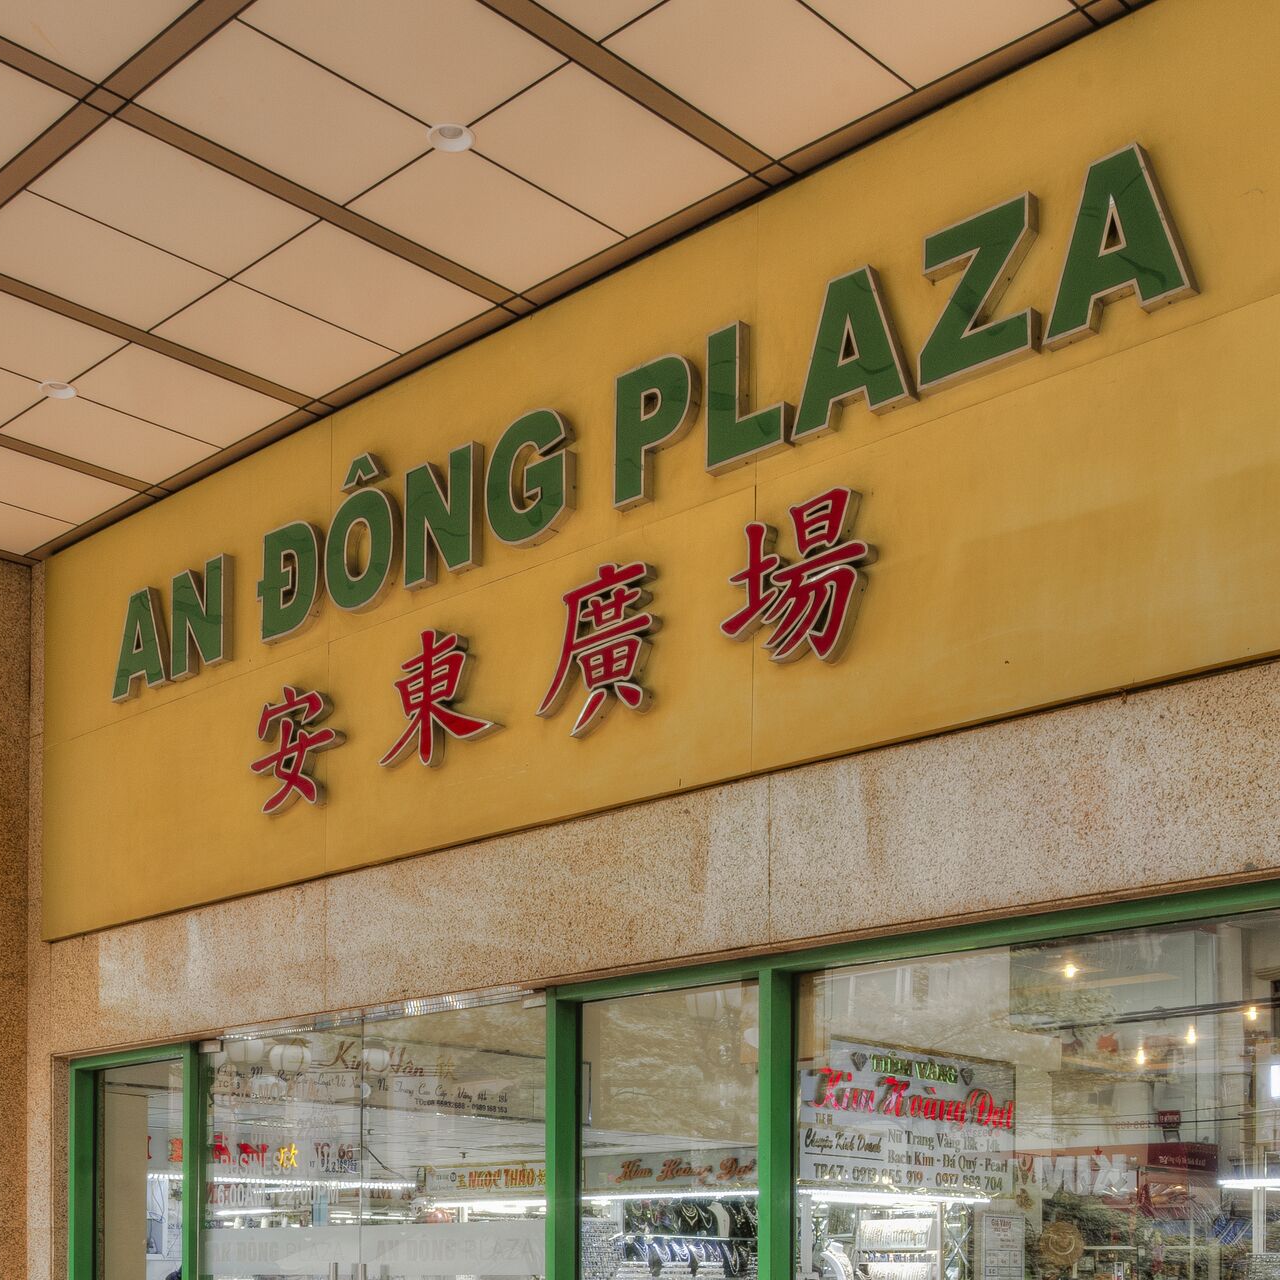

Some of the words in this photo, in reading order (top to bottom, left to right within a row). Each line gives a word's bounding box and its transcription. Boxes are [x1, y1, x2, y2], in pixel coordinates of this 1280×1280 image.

[110, 552, 235, 703] AN
[256, 408, 580, 645] ĐÔNG
[613, 139, 1202, 513] PLAZA
[249, 487, 880, 816] 安東廣場
[905, 1130, 934, 1150] Trang
[936, 1132, 961, 1153] Vàng
[615, 1157, 654, 1184] Kim
[914, 1151, 934, 1168] Kim
[985, 1157, 1008, 1173] Pearl
[906, 1170, 924, 1185] 919
[984, 1176, 1004, 1191] 704
